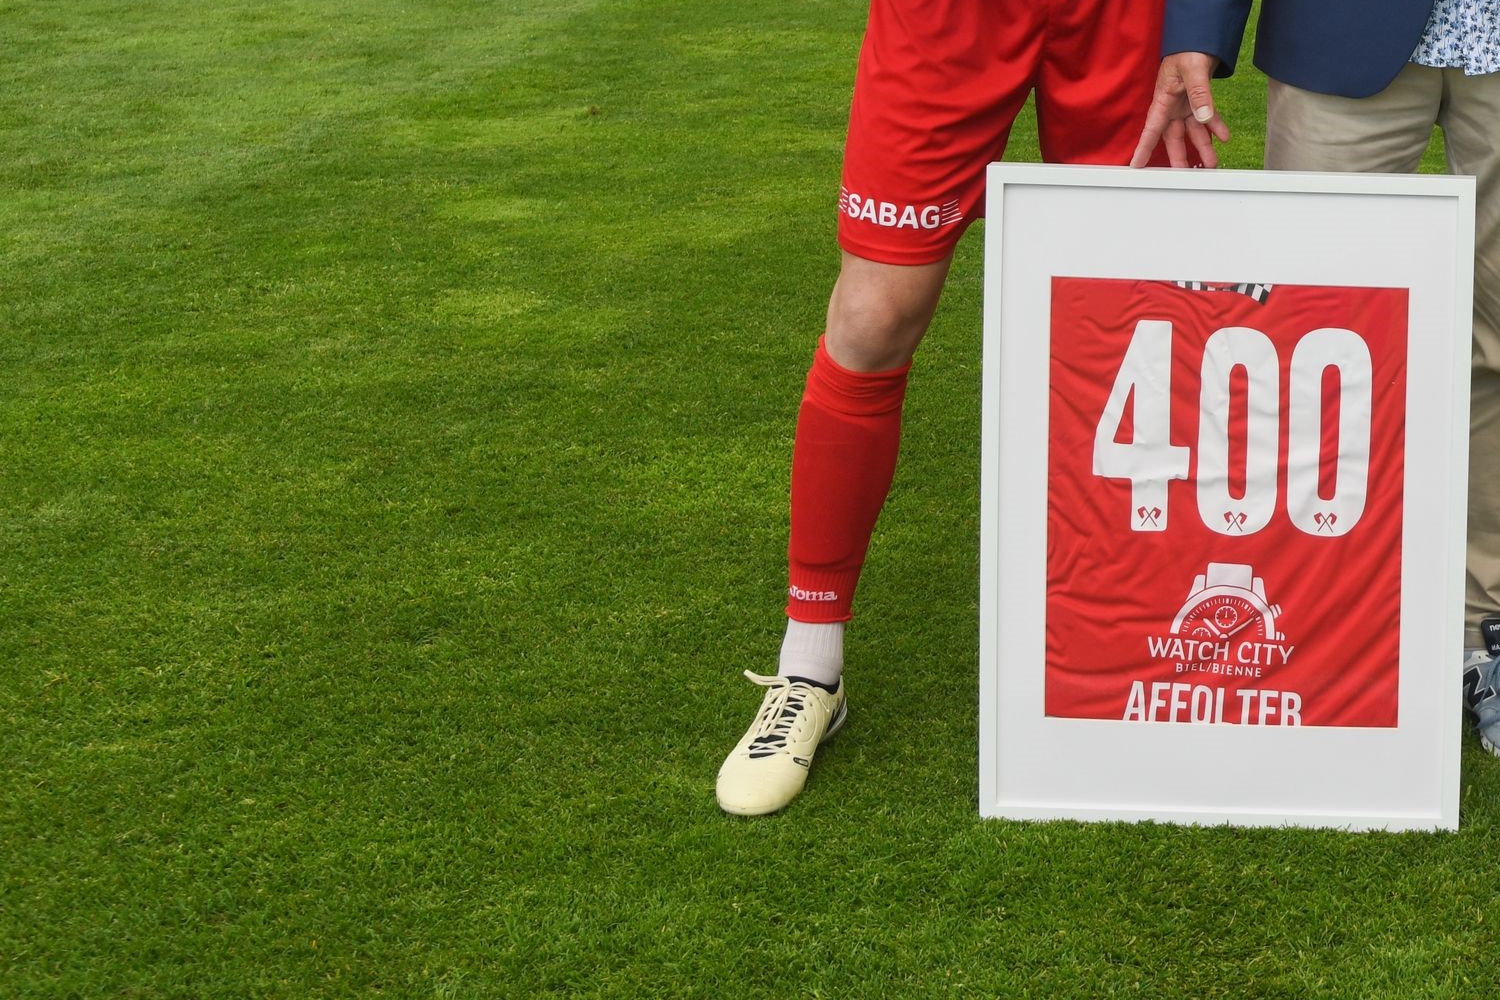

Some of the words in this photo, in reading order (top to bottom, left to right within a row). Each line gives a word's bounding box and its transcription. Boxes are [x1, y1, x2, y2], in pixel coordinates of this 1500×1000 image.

[847, 193, 940, 230] SABAG
[1092, 319, 1374, 538] 400
[1147, 636, 1230, 661] WATCH
[1237, 641, 1295, 666] CITY
[1175, 662, 1262, 678] BIEL/BIENNE
